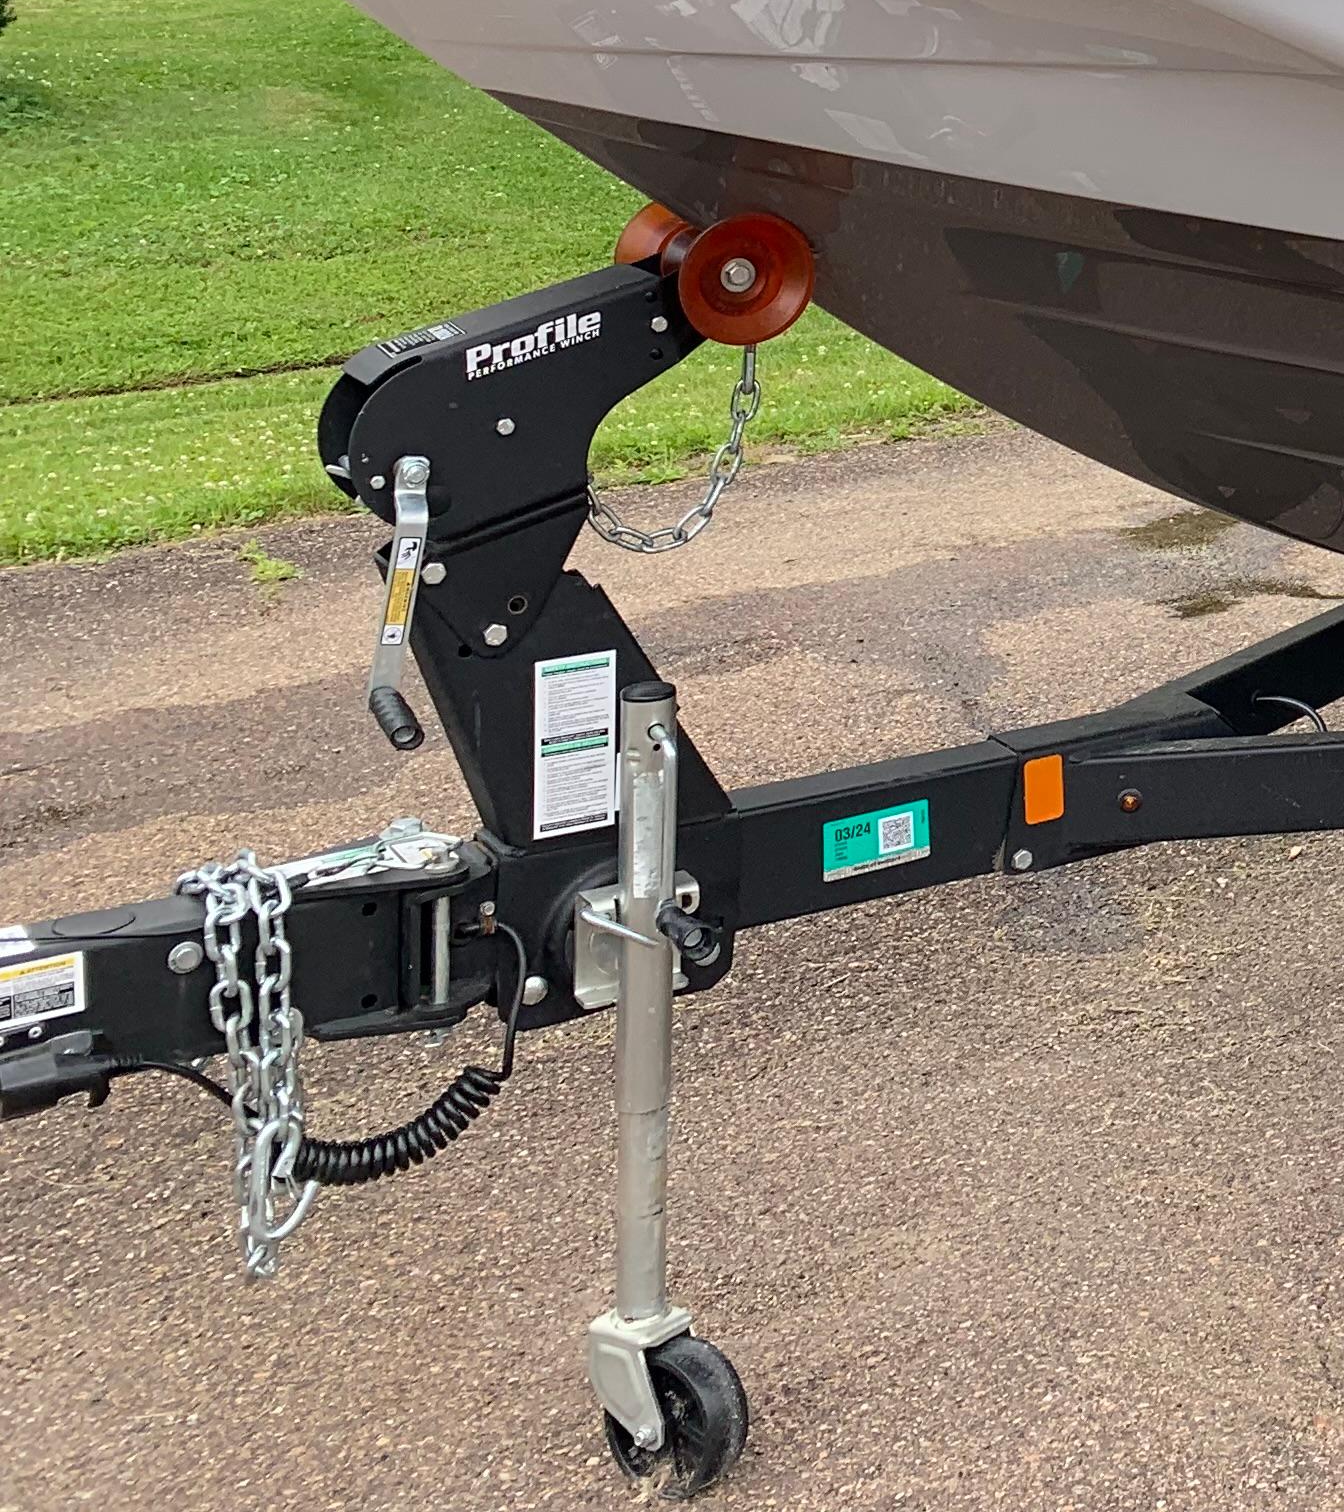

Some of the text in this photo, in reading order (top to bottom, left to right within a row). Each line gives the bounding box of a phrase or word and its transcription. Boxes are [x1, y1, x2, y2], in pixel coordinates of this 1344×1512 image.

[466, 311, 601, 373] Profile
[468, 328, 600, 381] PERFORMANCE WINCH
[834, 822, 871, 842] 03/24
